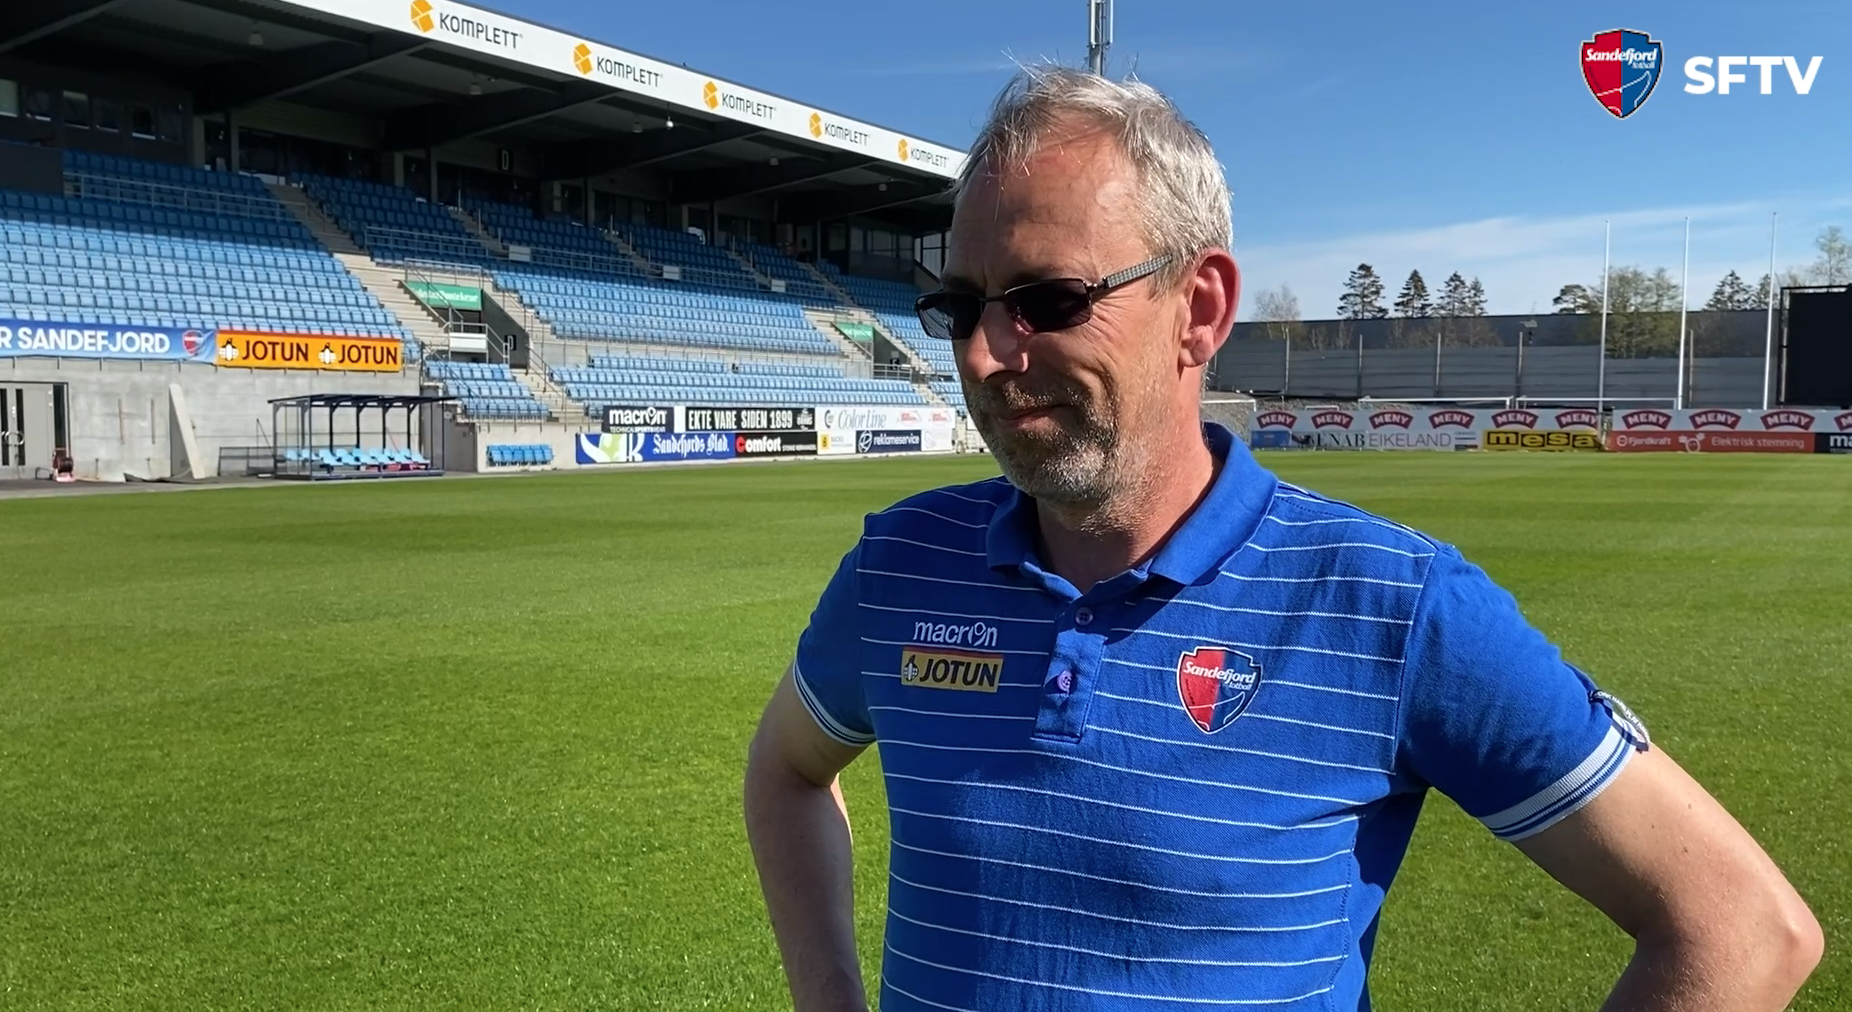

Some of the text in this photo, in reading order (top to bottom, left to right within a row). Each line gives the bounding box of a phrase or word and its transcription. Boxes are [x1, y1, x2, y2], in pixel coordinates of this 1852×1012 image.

[439, 12, 519, 49] KOMPLETT
[596, 55, 660, 87] KOMPLETT
[721, 92, 774, 120] KOMPLETT
[824, 122, 869, 146] KOMPLETT
[910, 147, 948, 168] KOMPLETT
[17, 327, 171, 354] SANDEFJORD
[242, 339, 309, 362] JOTUN
[338, 343, 398, 365] JOTUN
[609, 406, 667, 426] macron
[688, 410, 713, 431] EKTE
[714, 410, 737, 430] VARE
[741, 410, 768, 429] SIDEN
[769, 410, 793, 429] 1899
[1260, 414, 1293, 425] MENY
[1315, 414, 1350, 425] MENY
[1373, 413, 1409, 425] MENY
[1433, 413, 1470, 425] MENY
[1496, 413, 1534, 425] MENY
[1560, 413, 1598, 425] MENY
[1627, 413, 1667, 425] MENY
[1694, 413, 1736, 425] MENY
[1766, 413, 1809, 426] MENY
[736, 435, 781, 453] Comfort
[873, 432, 920, 446] reklameservice
[1369, 433, 1452, 448] EIKELAND
[1488, 431, 1596, 449] mesa
[1628, 436, 1672, 447] Fjordkraft
[1711, 436, 1755, 446] Elektrisk
[912, 621, 998, 647] macron
[919, 658, 999, 688] JOTUN
[1183, 660, 1257, 684] Sandefjord
[1228, 680, 1252, 691] fotball
